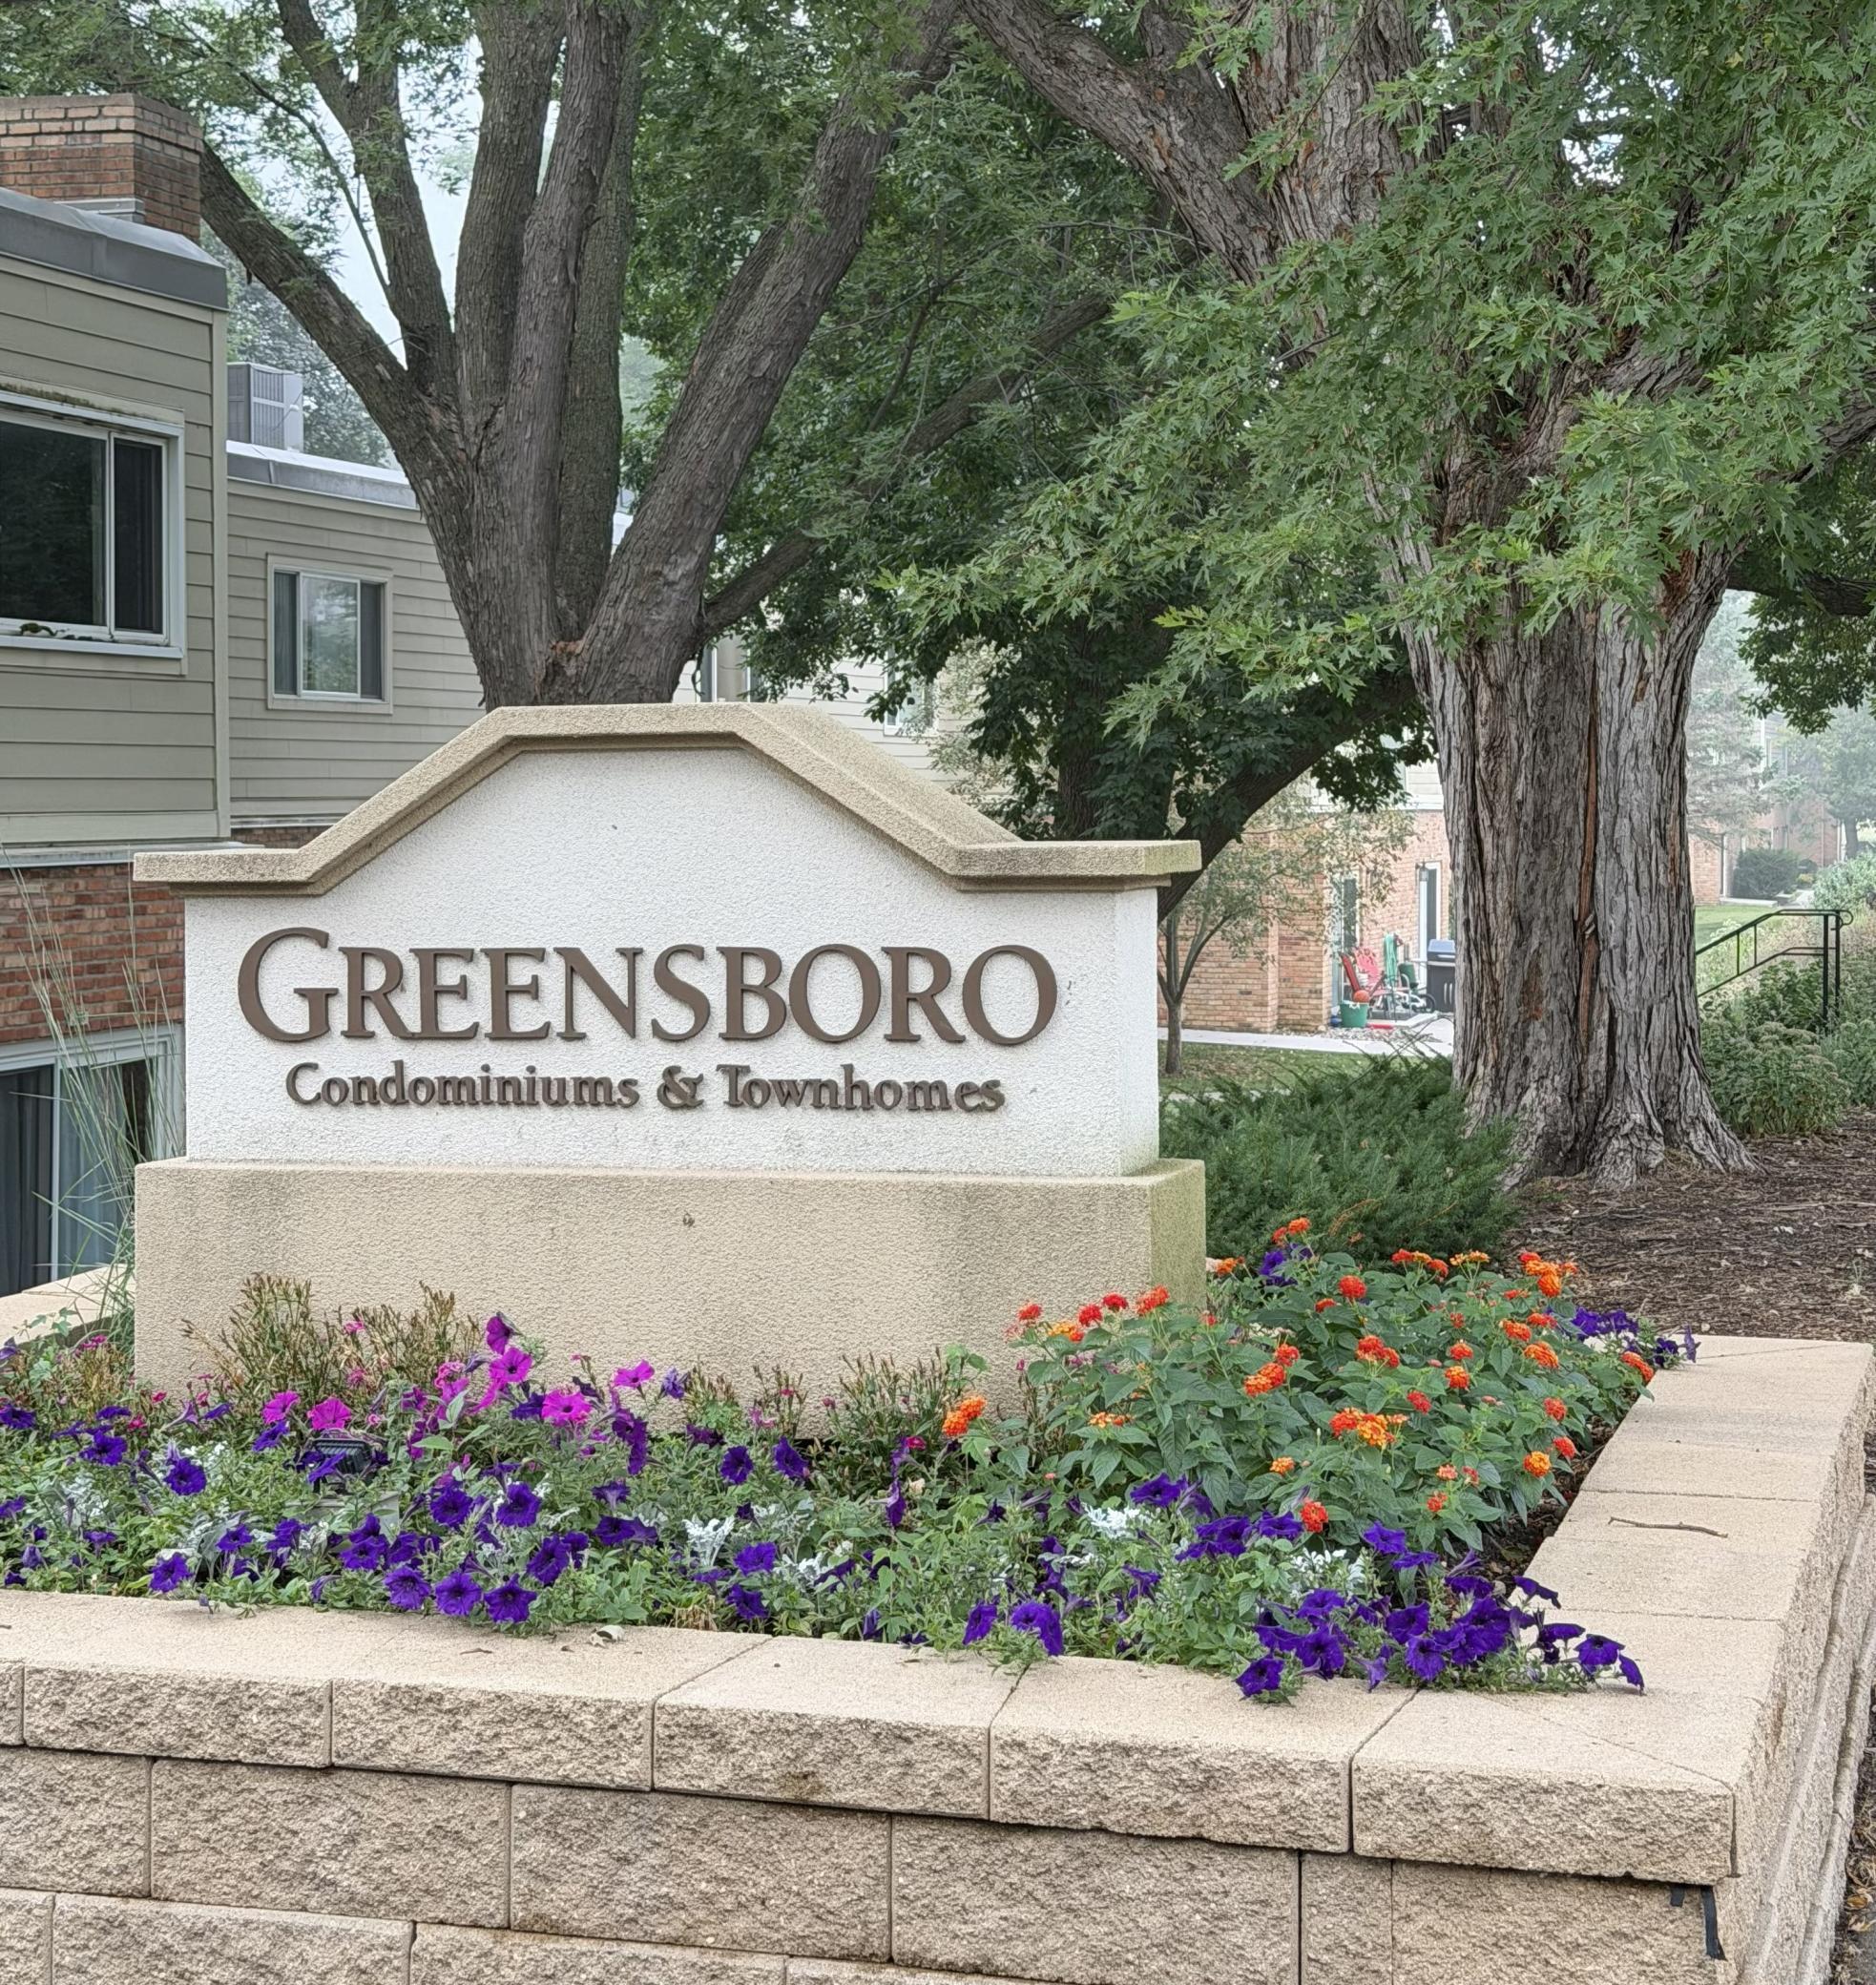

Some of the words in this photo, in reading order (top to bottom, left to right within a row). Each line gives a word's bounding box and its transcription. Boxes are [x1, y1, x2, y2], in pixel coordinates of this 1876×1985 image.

[238, 927, 1058, 1048] GREENSBORO
[284, 1060, 640, 1110] Condominiums
[657, 1064, 705, 1112] &
[715, 1063, 1006, 1114] Townhomes
